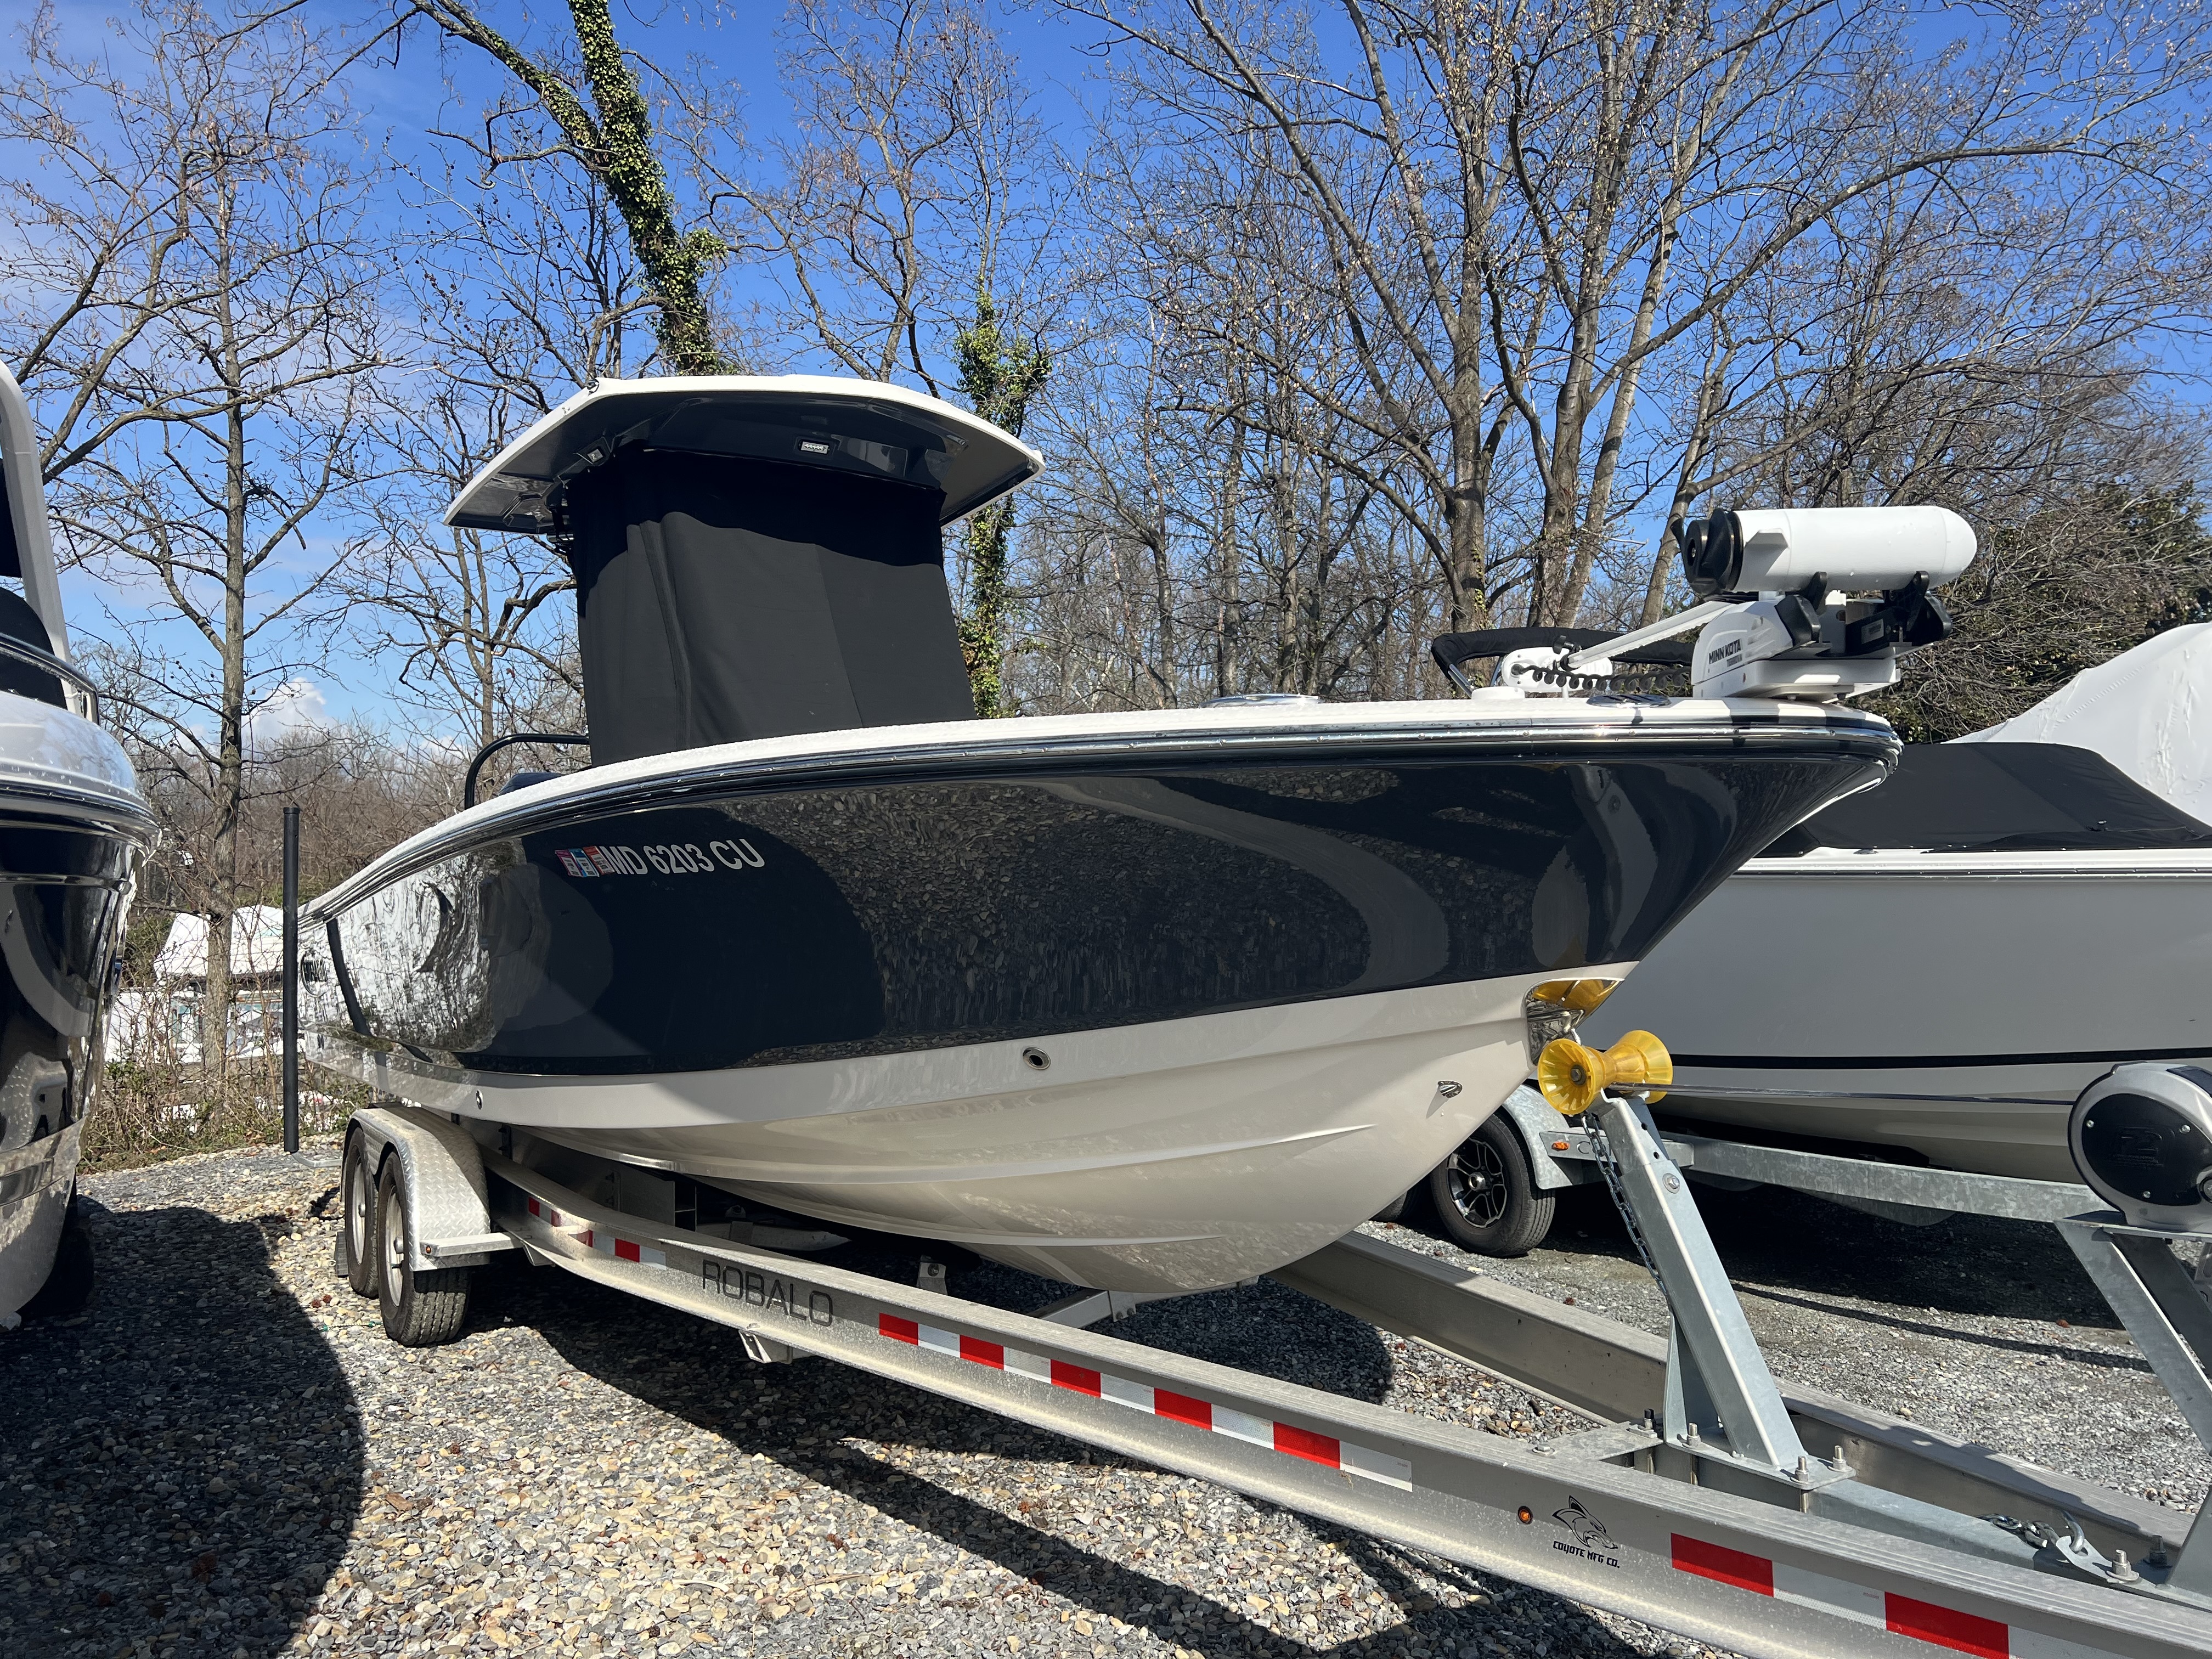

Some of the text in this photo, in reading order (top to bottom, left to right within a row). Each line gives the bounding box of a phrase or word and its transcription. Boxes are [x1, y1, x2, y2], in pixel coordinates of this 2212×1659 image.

[1709, 646, 1724, 665] MINN
[1725, 639, 1741, 657] KOTA
[600, 847, 648, 874] MD
[643, 843, 715, 874] 6203
[709, 839, 765, 870] CU
[702, 1259, 833, 1327] ROBALO
[1553, 1541, 1620, 1568] COYOTE MFG CO.
